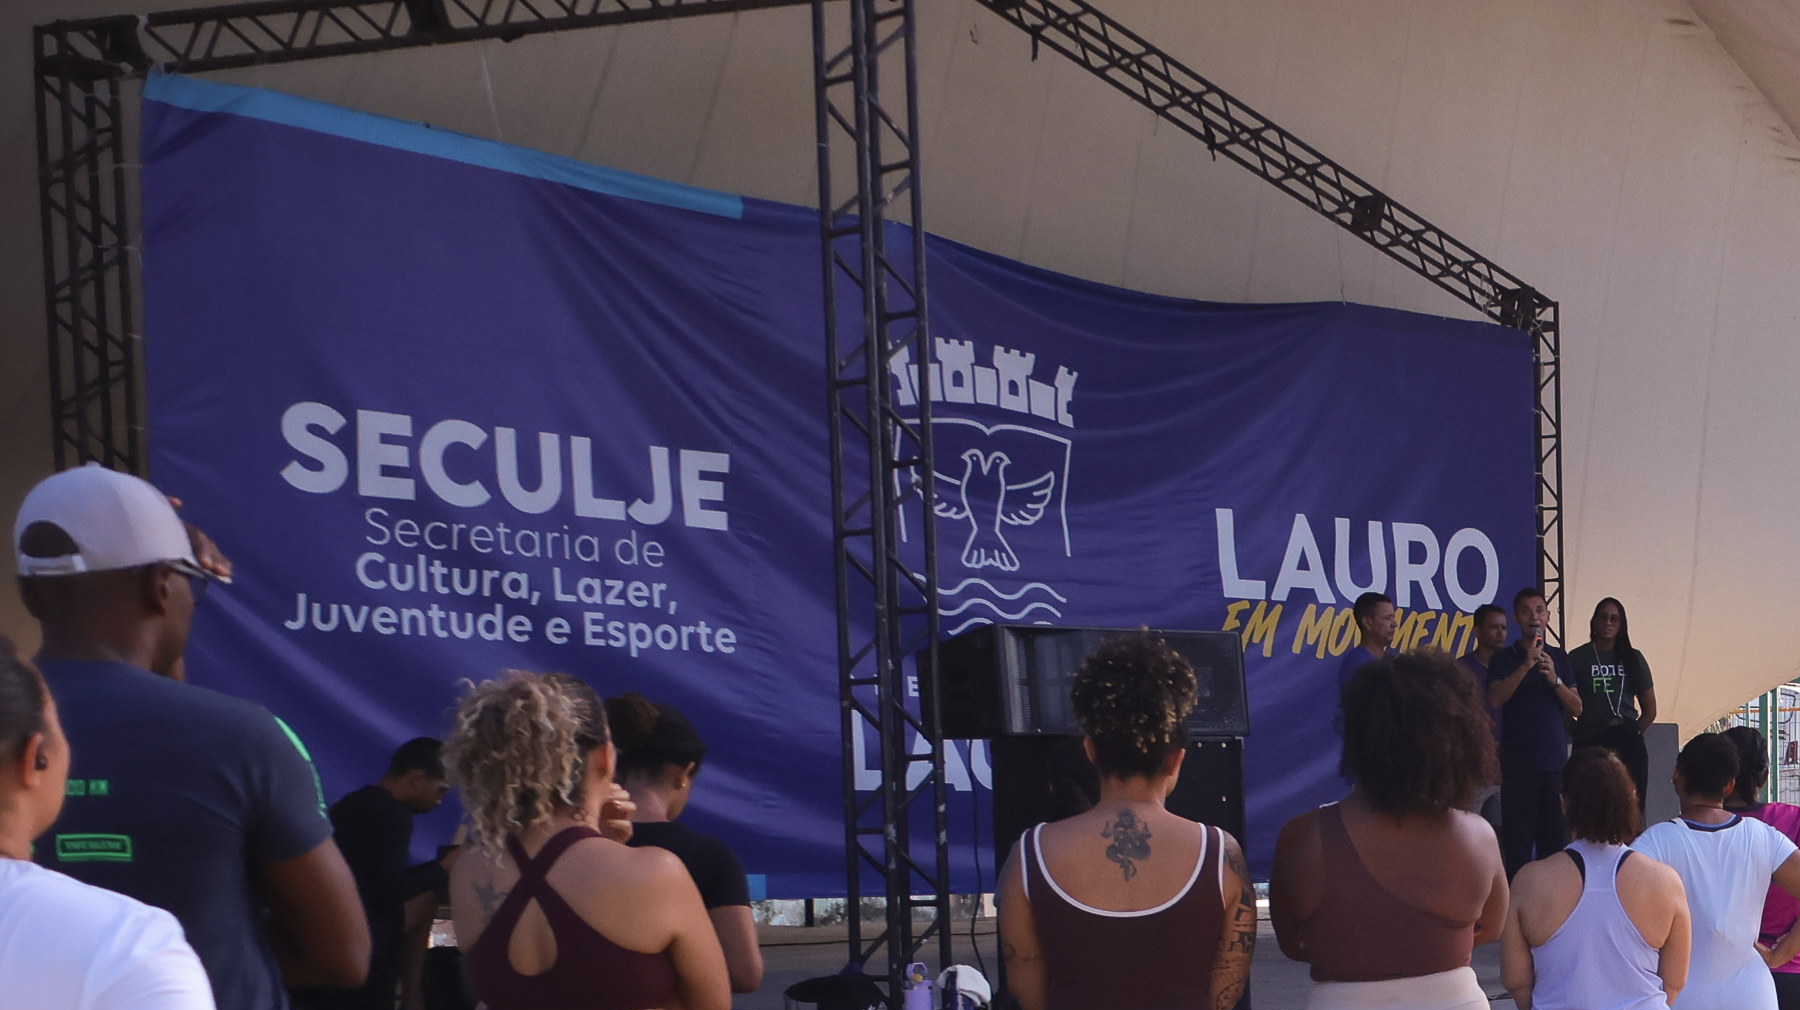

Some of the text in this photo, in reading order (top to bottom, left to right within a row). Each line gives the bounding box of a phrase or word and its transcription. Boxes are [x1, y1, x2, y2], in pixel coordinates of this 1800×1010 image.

[280, 401, 730, 532] SECULJE
[365, 507, 665, 568] Secretaria de
[1214, 507, 1500, 614] LAURO
[355, 552, 677, 615] Cultura, Lazer,
[284, 593, 737, 658] Juventude e Esporte
[1591, 664, 1624, 677] BOTE
